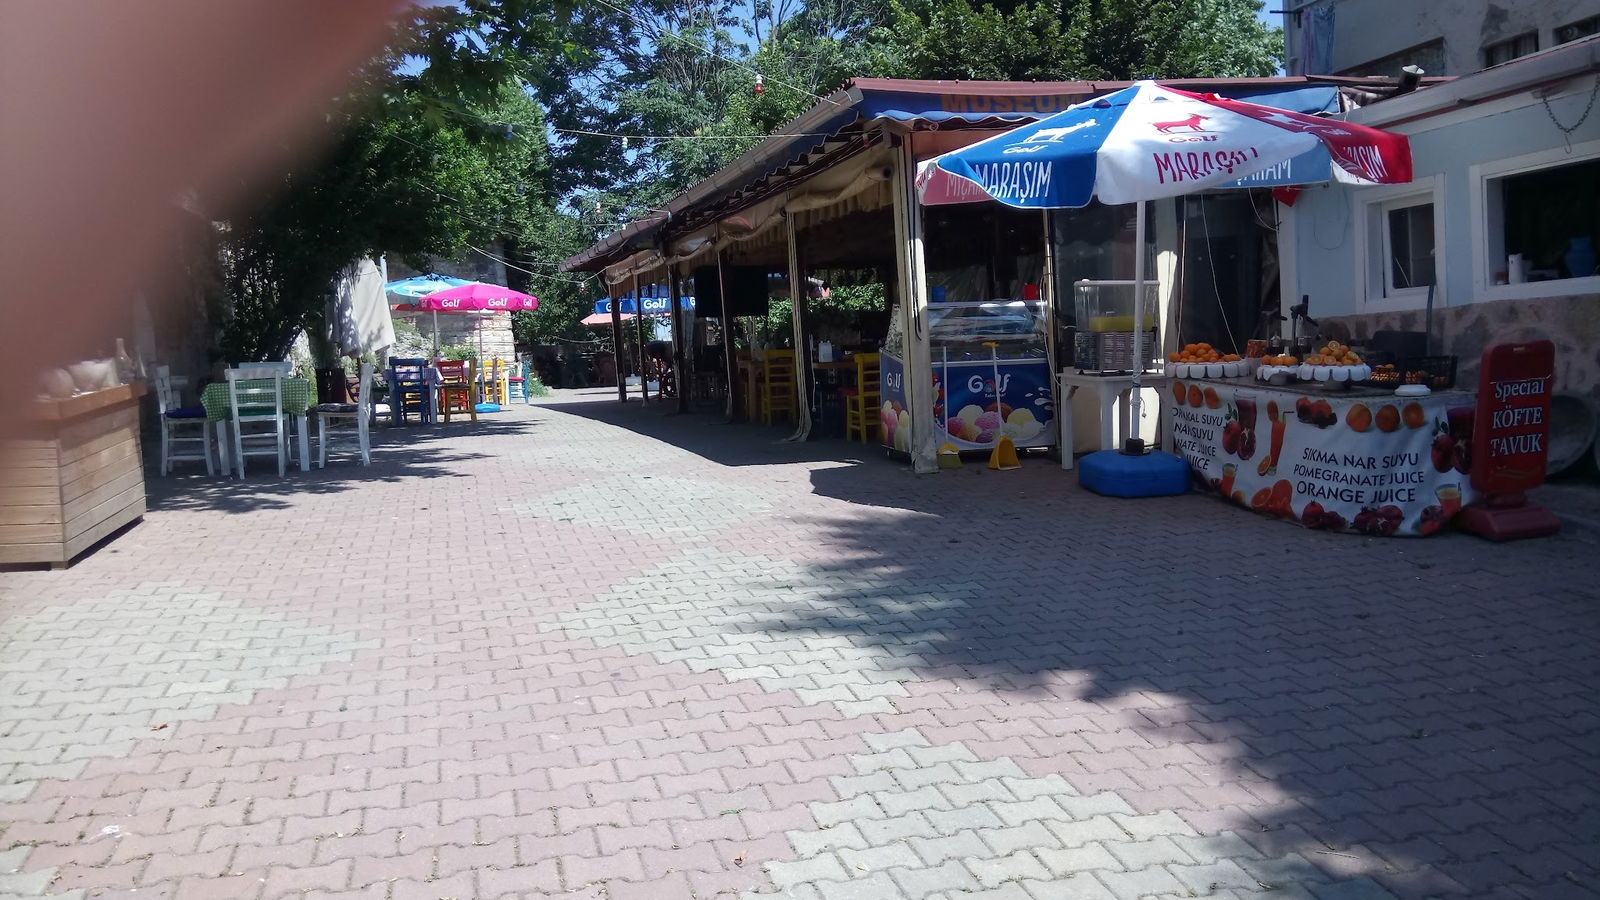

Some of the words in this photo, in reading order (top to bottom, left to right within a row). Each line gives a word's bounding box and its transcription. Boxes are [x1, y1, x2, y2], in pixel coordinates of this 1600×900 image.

[441, 299, 460, 308] Golf
[487, 297, 508, 307] Golf
[606, 302, 622, 312] Gf
[643, 298, 668, 309] Golf
[1494, 379, 1545, 402] Special
[1202, 414, 1223, 427] SUYU
[1492, 405, 1543, 429] KÖFTE
[1192, 427, 1214, 441] SUYU
[1490, 433, 1543, 456] TAVUK
[1302, 447, 1338, 466] SIKMA
[1343, 455, 1377, 470] NAR
[1382, 453, 1419, 469] SUYU
[1293, 463, 1386, 487] POMEGRANATE
[1389, 471, 1424, 485] JUICE
[1296, 480, 1365, 504] ORANGE
[1371, 488, 1416, 504] JUICE
